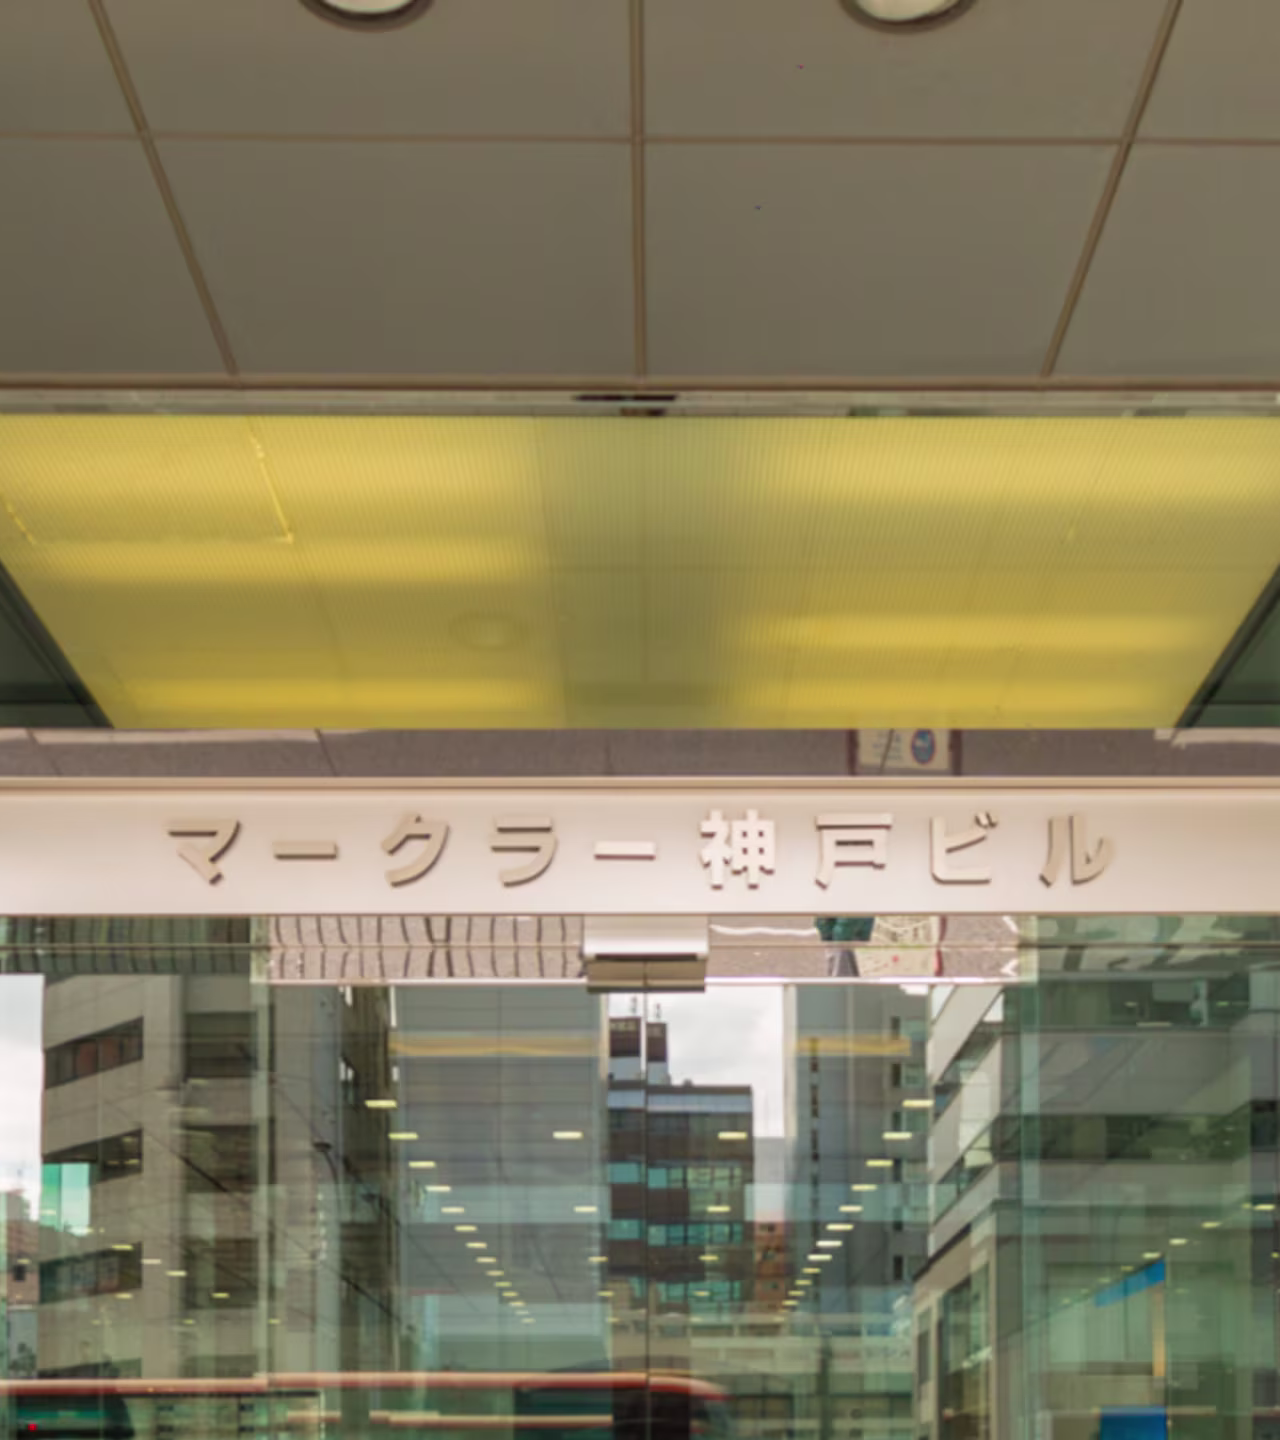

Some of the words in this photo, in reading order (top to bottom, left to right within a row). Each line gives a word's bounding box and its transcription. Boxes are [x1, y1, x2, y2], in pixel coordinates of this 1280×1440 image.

[163, 810, 1116, 889] マークラー神戸ビル
